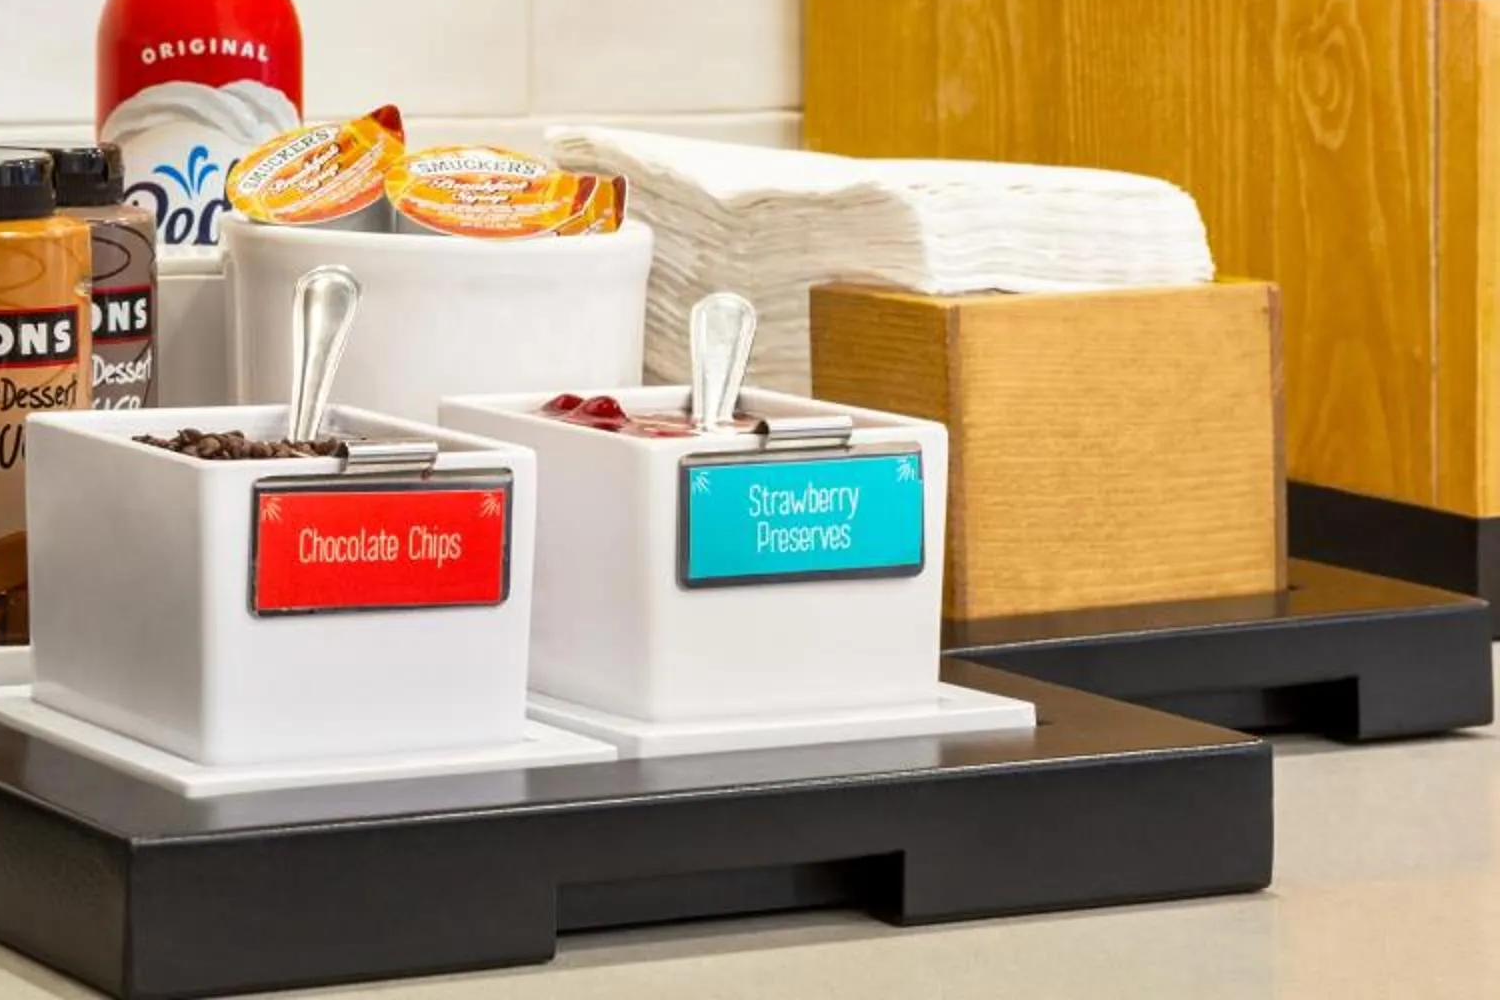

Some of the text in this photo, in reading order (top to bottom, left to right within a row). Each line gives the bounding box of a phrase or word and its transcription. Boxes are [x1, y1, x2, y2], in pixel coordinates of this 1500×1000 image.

[141, 37, 270, 65] ORIGINAL
[92, 298, 147, 332] NS
[0, 374, 78, 412] Dessert
[748, 480, 861, 520] Strawberry
[299, 525, 462, 569] Chocolate Chips
[756, 520, 852, 553] Preserves
